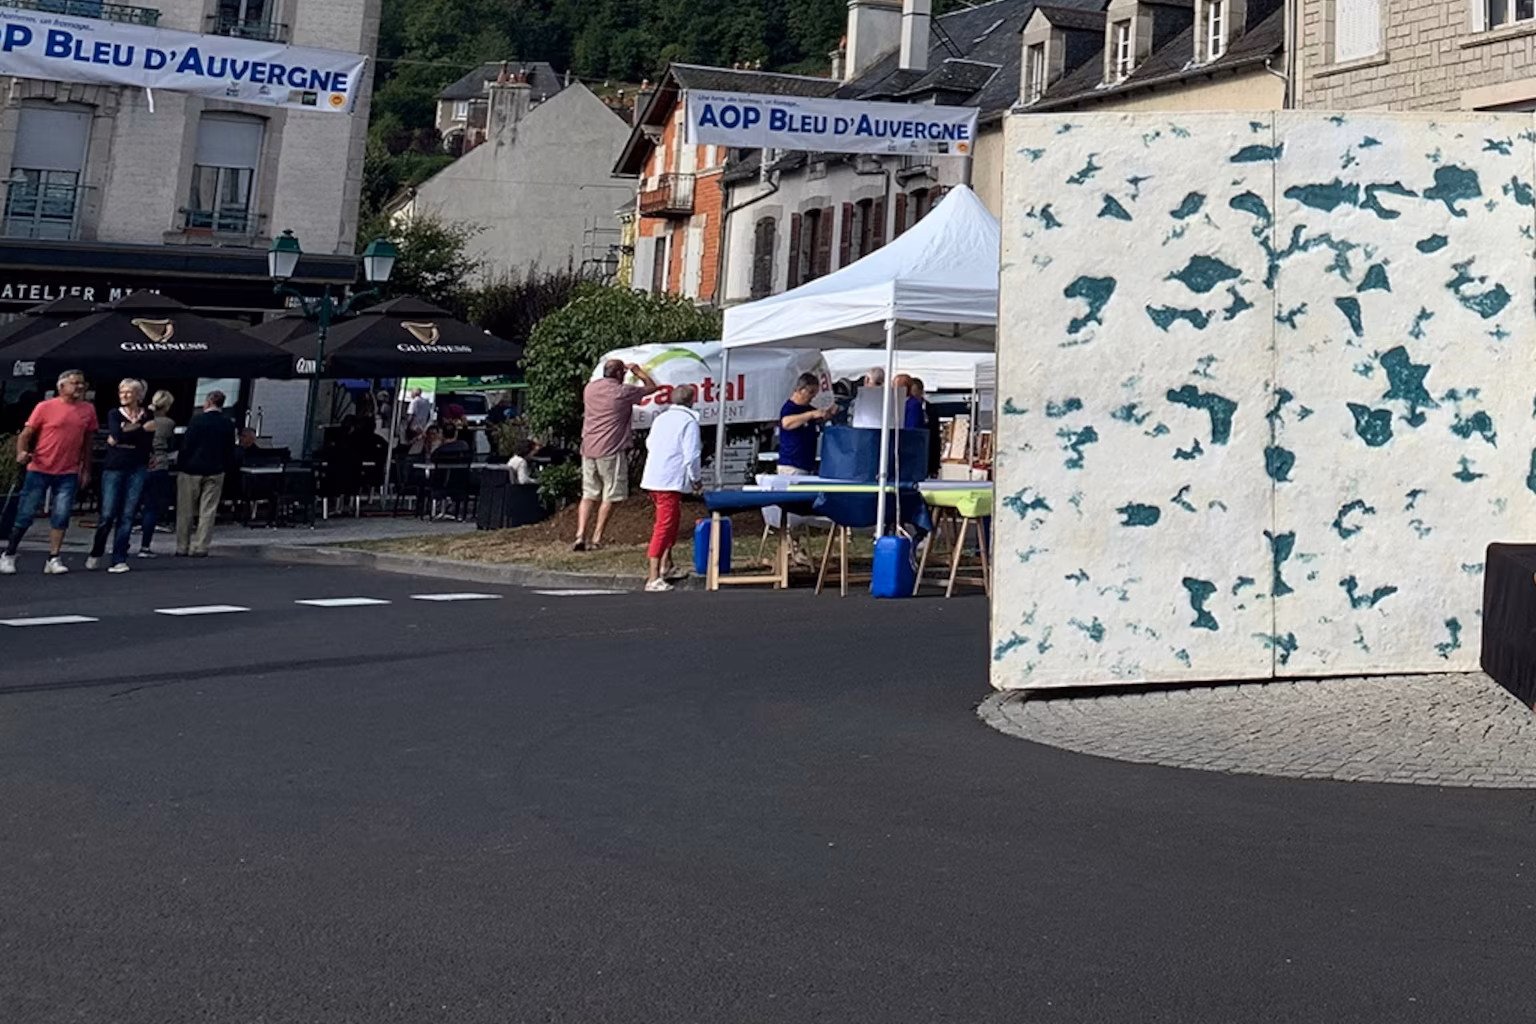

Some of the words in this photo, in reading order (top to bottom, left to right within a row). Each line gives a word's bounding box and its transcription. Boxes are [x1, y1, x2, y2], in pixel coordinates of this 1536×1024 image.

[0, 23, 33, 52] P
[45, 29, 135, 67] BLEU
[143, 47, 348, 93] D'AUVERGNE
[699, 103, 761, 129] AOP
[769, 108, 828, 134] BLEU
[834, 113, 970, 140] D'AUVERGNE
[120, 342, 208, 352] GUINNESS
[397, 343, 473, 353] GUINNESS
[639, 374, 745, 406] atal
